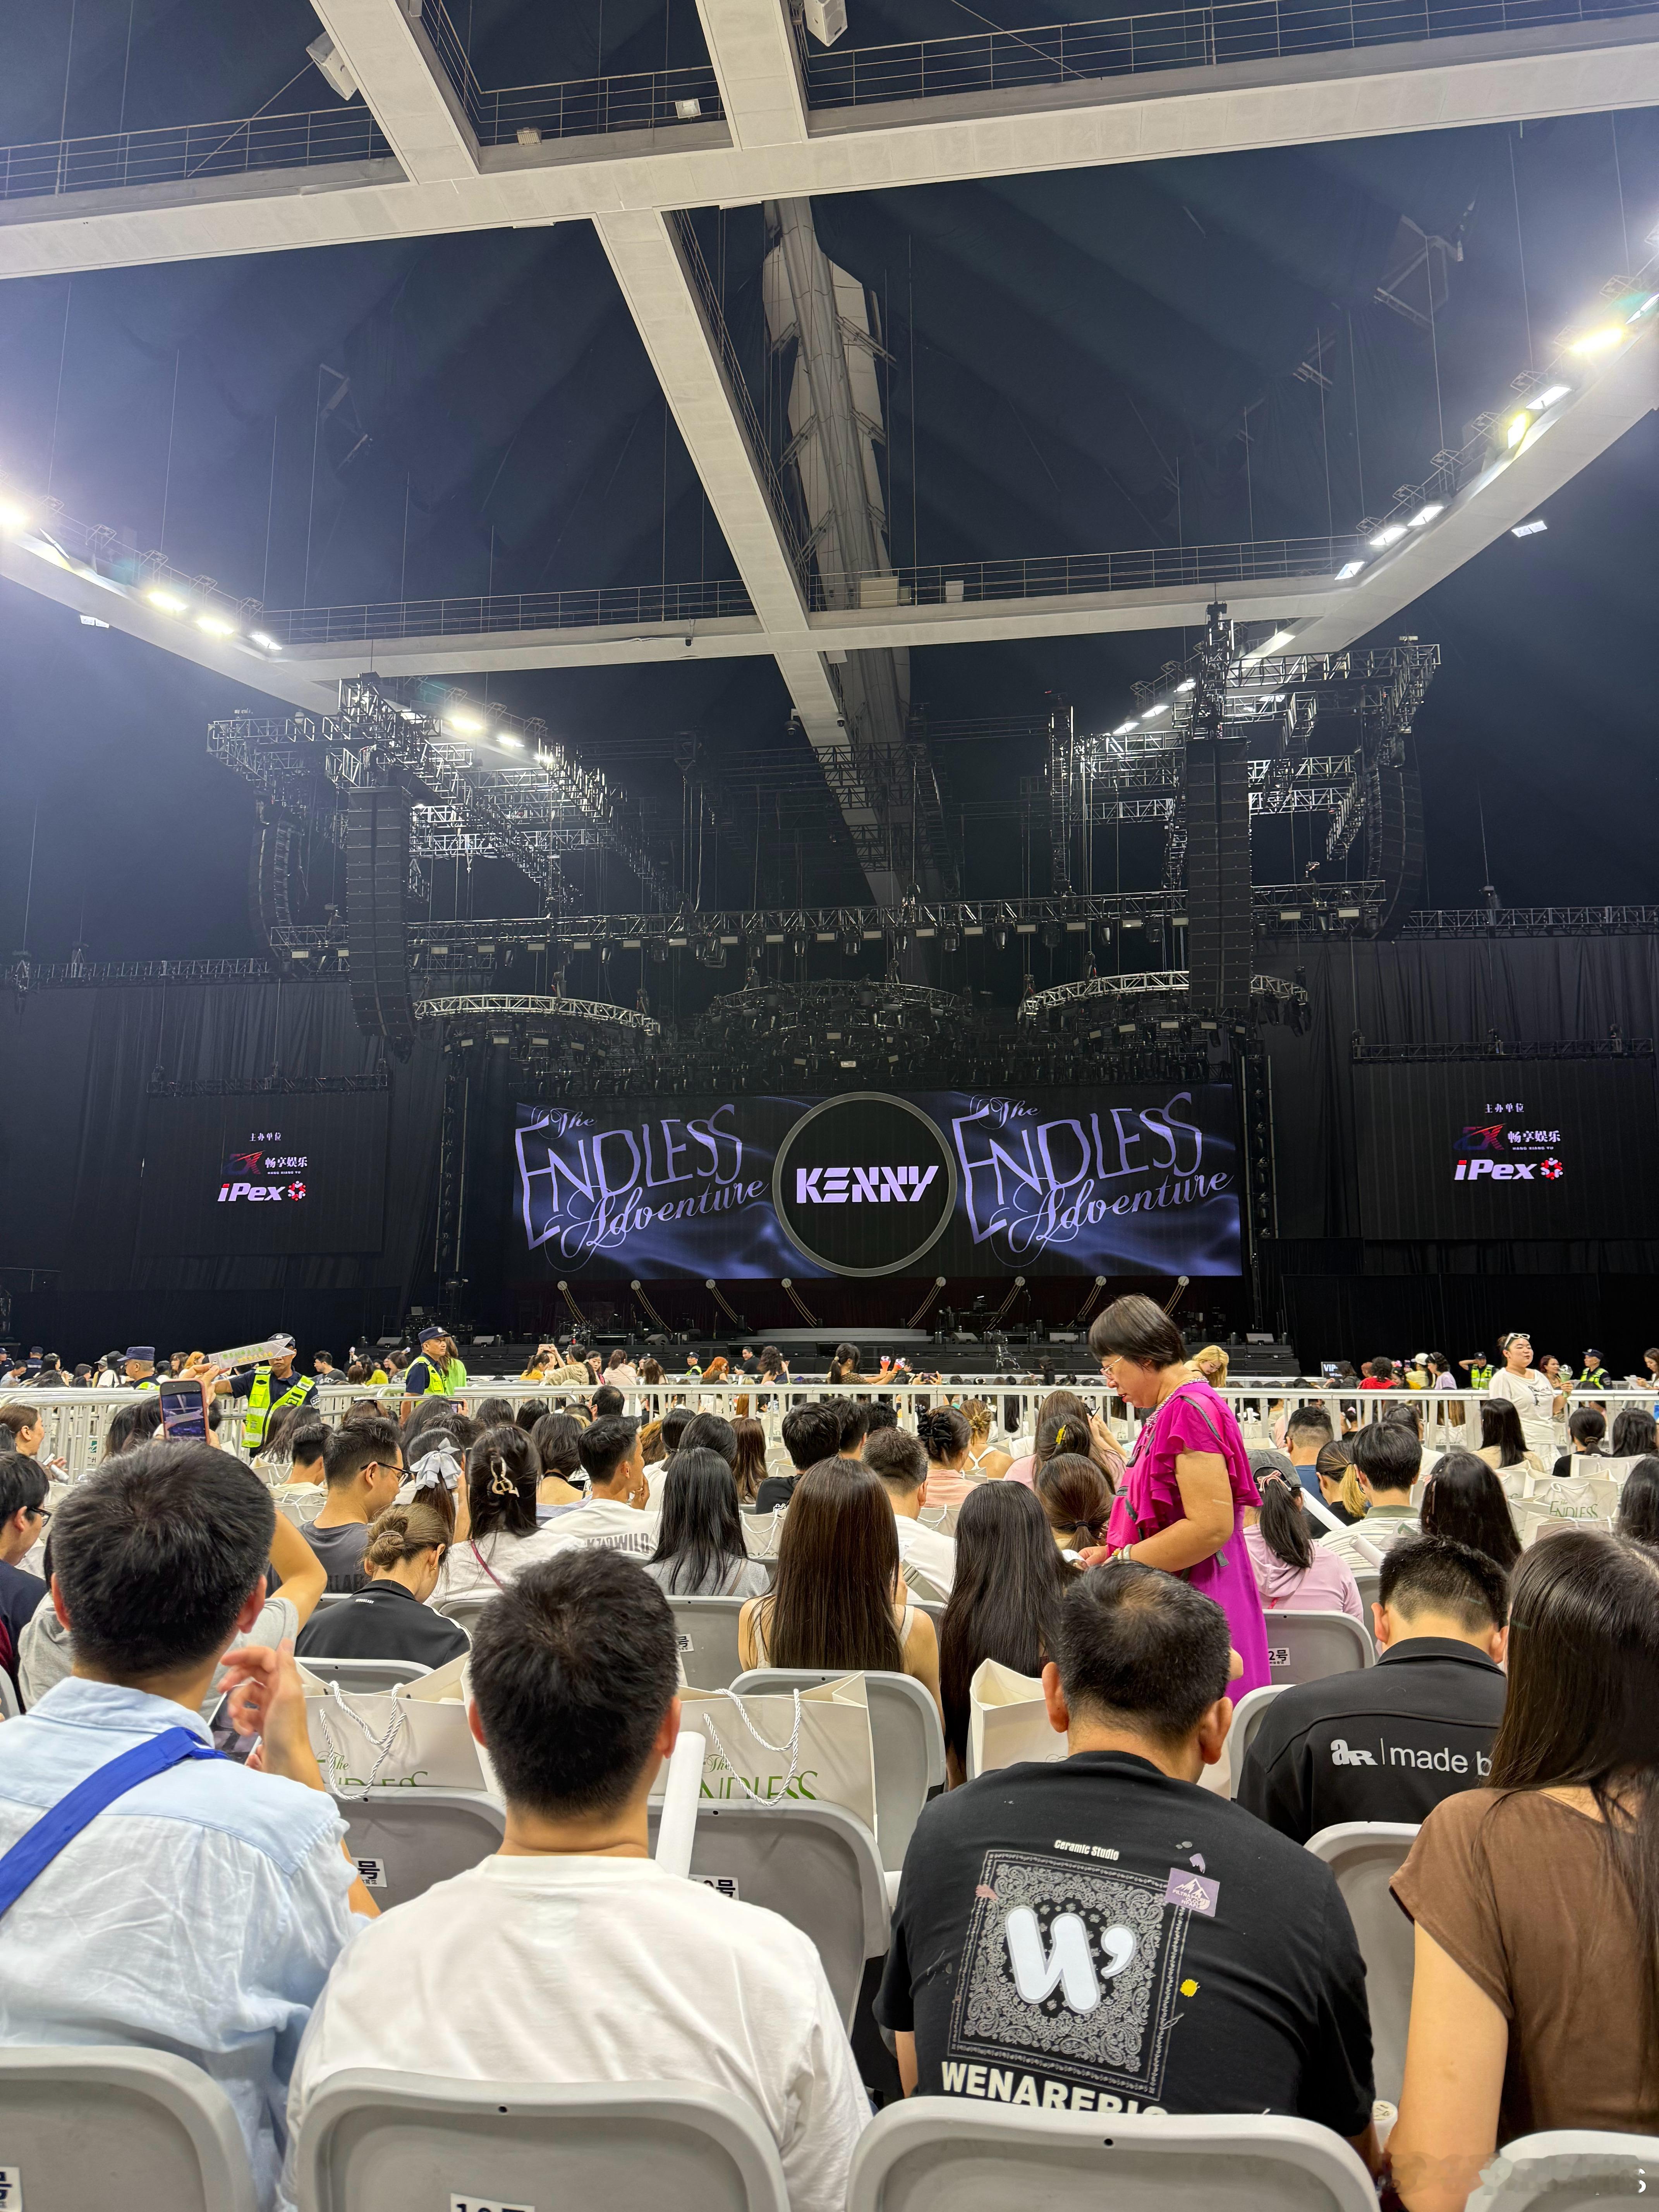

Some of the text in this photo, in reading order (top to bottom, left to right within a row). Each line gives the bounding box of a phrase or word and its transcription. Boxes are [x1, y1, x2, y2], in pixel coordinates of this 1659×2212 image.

[1485, 1103, 1524, 1113] 主办单位
[249, 1132, 282, 1142] 主办单位
[1508, 1130, 1561, 1143] 畅享娱乐
[265, 1156, 307, 1168] 畅享娱乐
[952, 1092, 1202, 1244] ENDLESS
[1454, 1159, 1537, 1180] iPex
[515, 1104, 742, 1250] ENDLESS
[797, 1166, 939, 1203] KENNY
[217, 1183, 286, 1202] iPex
[544, 1180, 769, 1273] Adventure
[989, 1172, 1235, 1267] Adventure
[1390, 1747, 1468, 1774] made
[1054, 1839, 1120, 1861] Ceramic Studio
